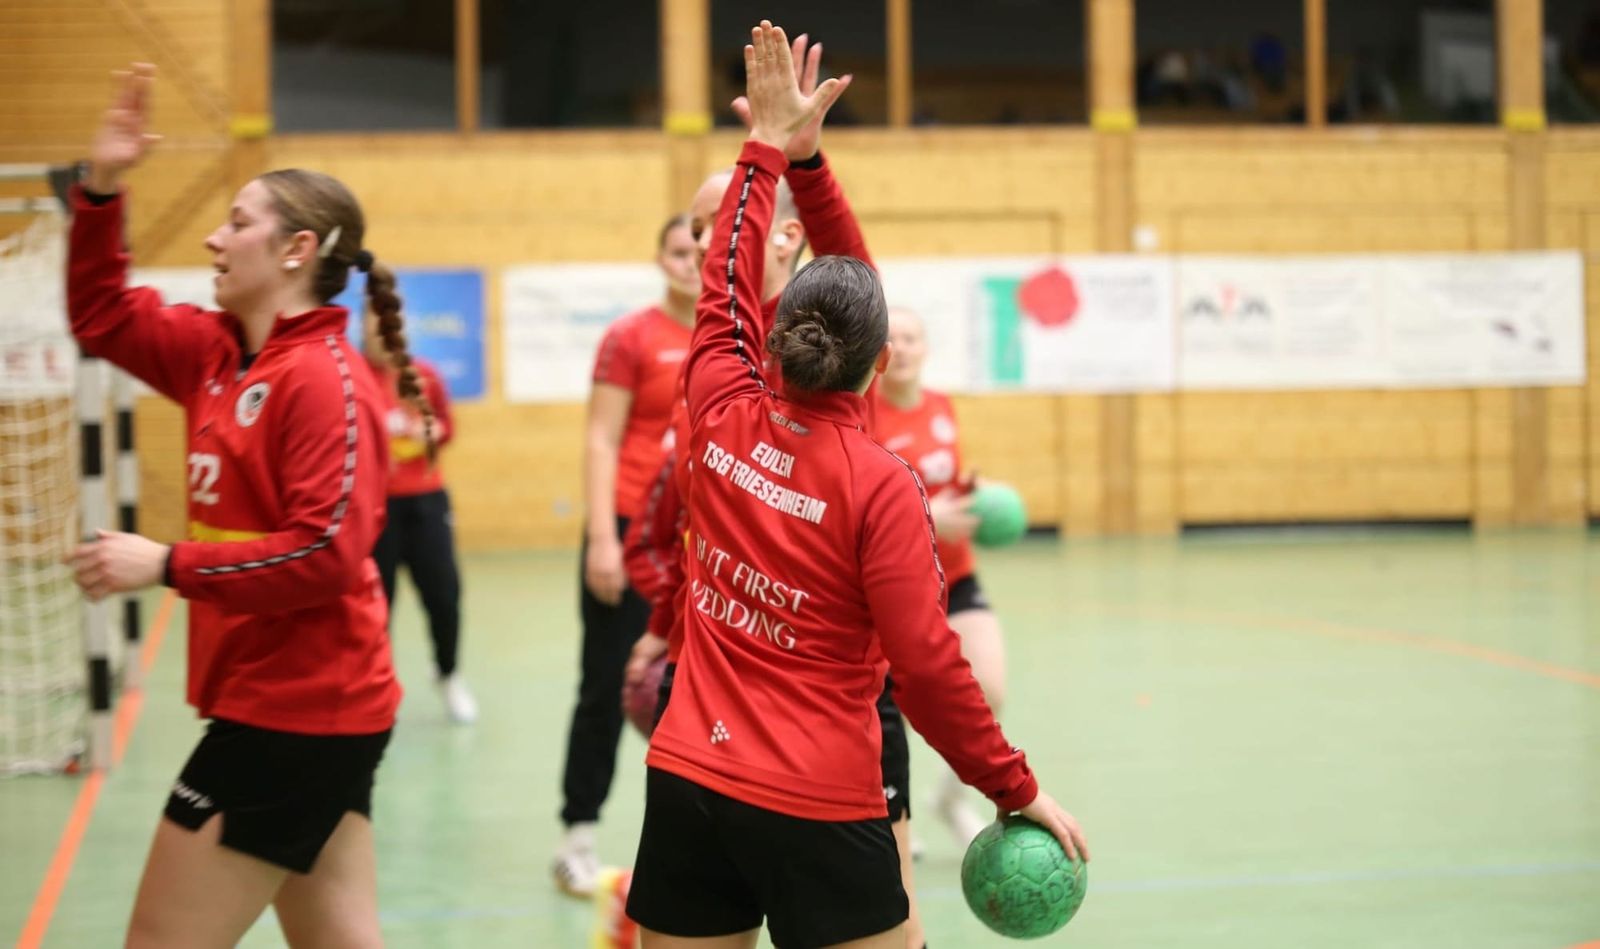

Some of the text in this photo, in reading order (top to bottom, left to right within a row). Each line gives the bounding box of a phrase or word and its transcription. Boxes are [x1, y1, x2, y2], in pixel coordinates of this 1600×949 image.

[702, 441, 827, 524] TSG FRIESENHEIM
[750, 442, 794, 478] EULEN
[732, 561, 810, 614] FIRST
